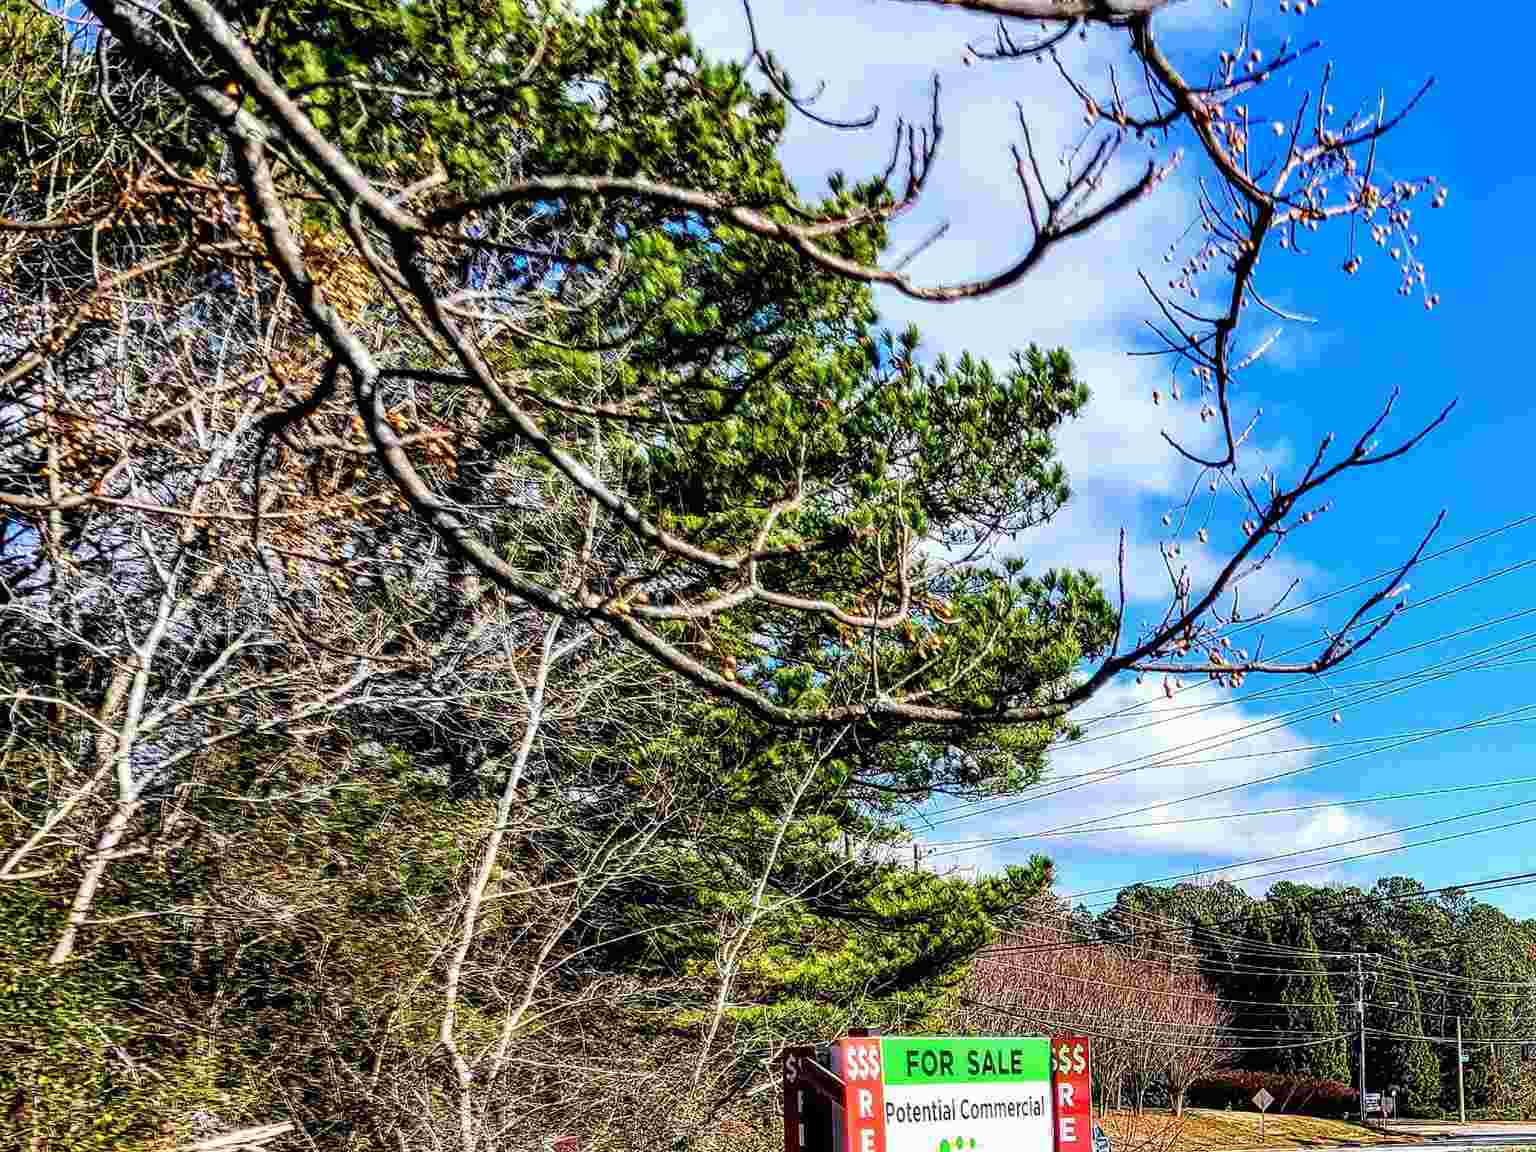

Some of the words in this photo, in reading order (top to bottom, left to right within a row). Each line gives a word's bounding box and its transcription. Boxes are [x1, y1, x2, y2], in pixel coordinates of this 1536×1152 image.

[906, 1049, 954, 1077] FOR
[967, 1049, 1024, 1076] SALE
[885, 1098, 956, 1124] Potential
[960, 1095, 1045, 1120] Commercial
